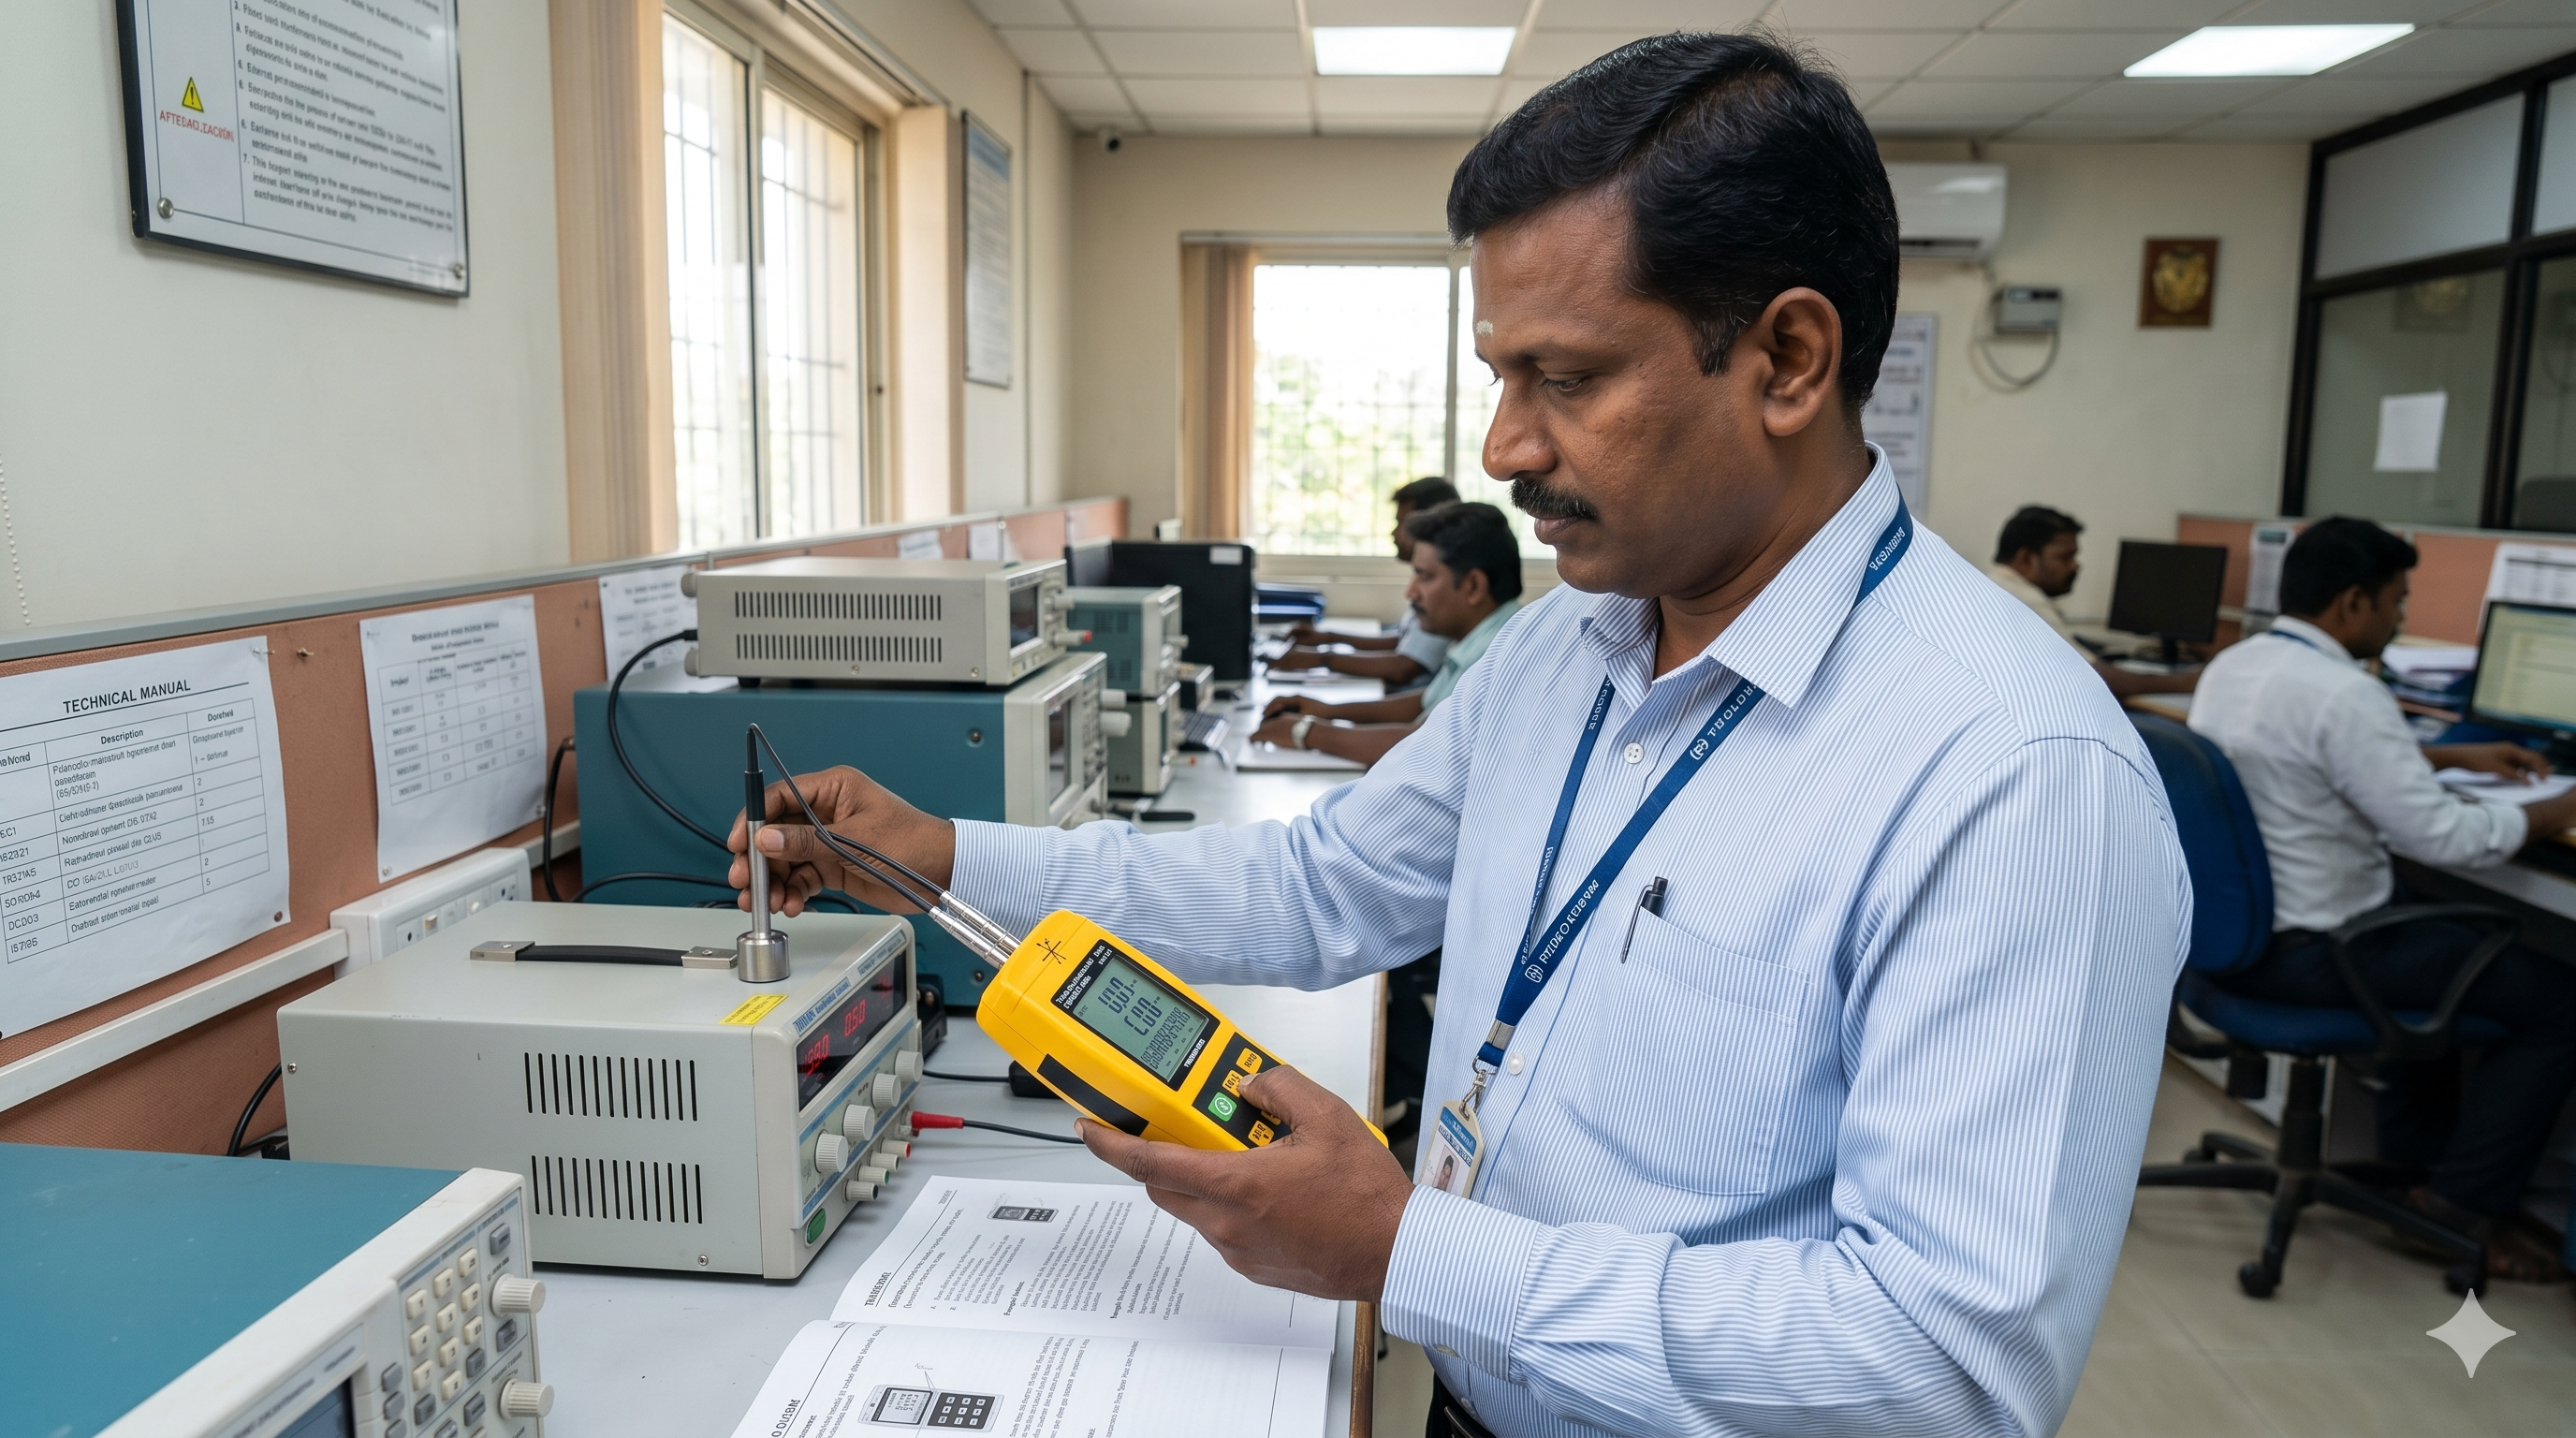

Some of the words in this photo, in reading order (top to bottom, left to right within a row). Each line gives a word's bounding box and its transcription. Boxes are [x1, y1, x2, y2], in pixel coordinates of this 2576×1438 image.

[63, 689, 137, 713] TECHNICAL
[140, 680, 191, 700] MANUAL
[100, 728, 144, 745] Description
